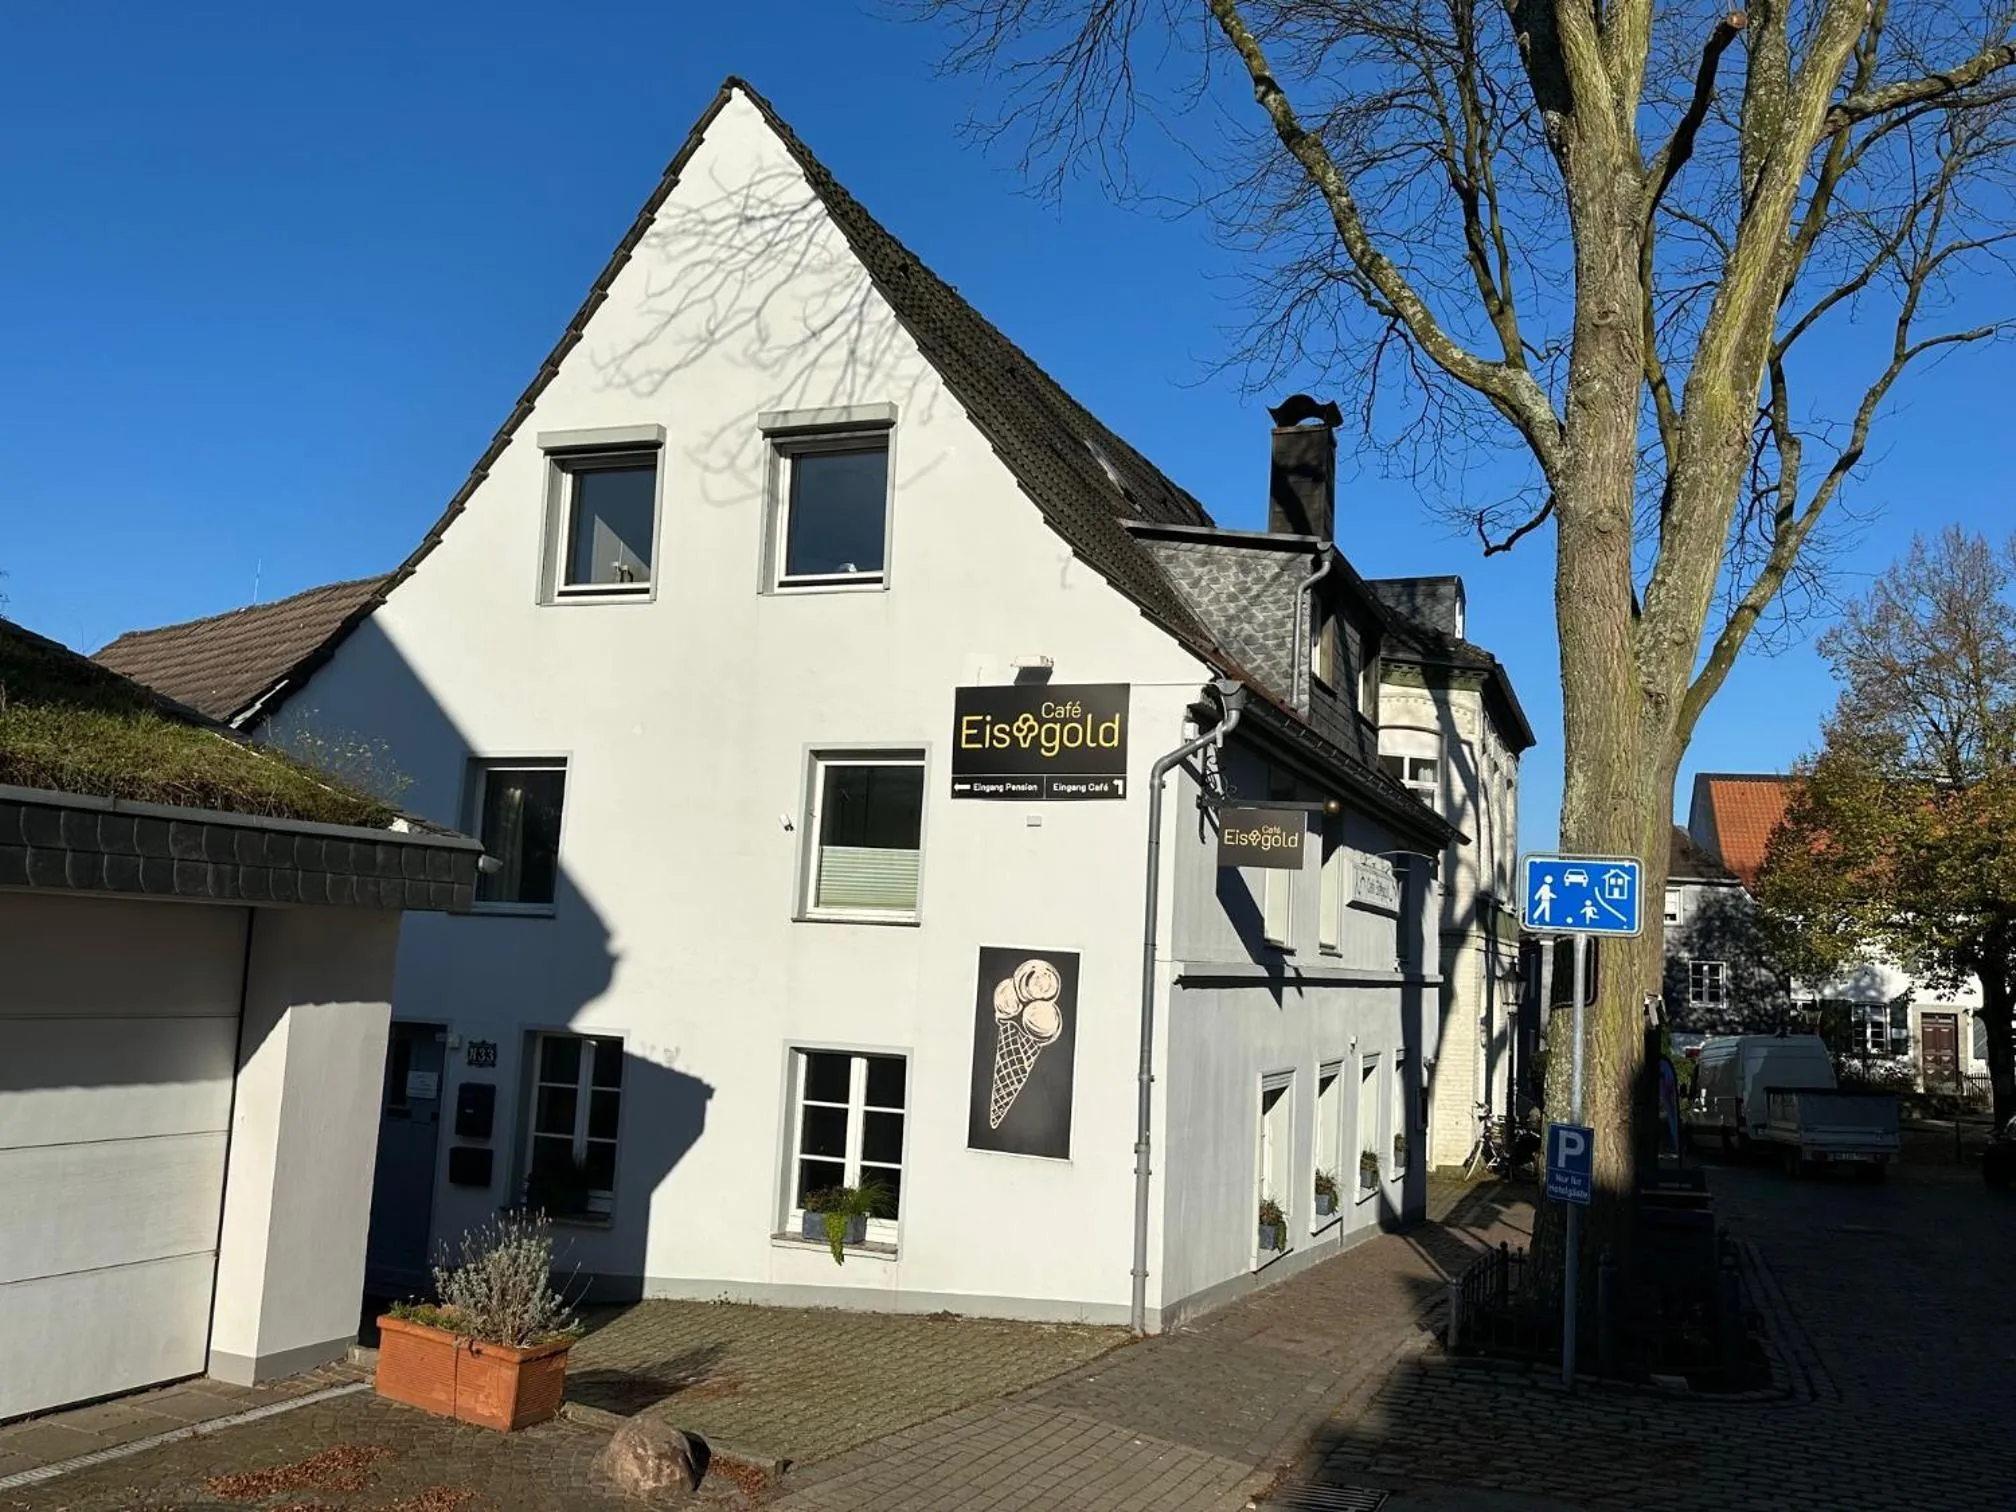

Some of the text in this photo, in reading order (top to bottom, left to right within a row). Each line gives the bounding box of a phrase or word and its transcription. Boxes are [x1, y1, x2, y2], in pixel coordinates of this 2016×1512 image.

[1041, 701, 1082, 718] Café
[973, 782, 1038, 793] Eingang Pension
[1053, 781, 1109, 793] Eingang Café
[1261, 825, 1281, 834] Café
[1558, 1130, 1585, 1168] P
